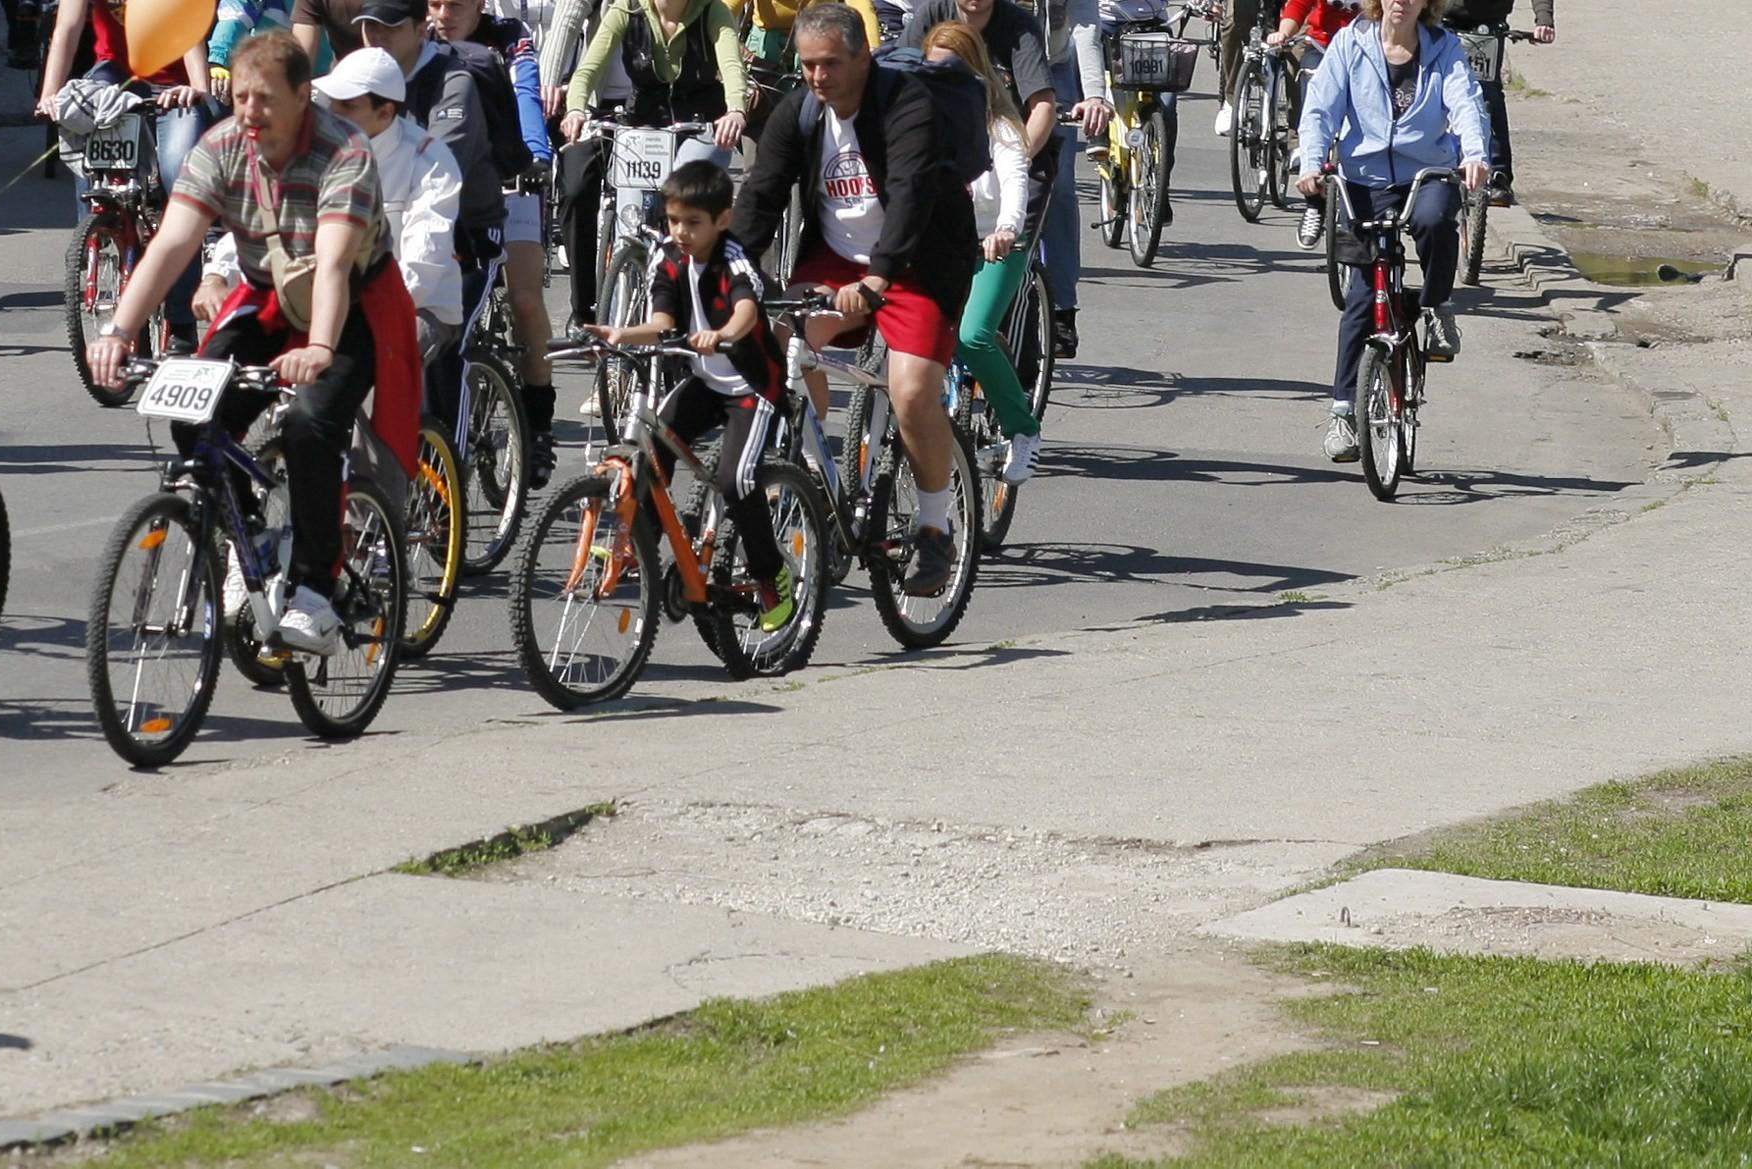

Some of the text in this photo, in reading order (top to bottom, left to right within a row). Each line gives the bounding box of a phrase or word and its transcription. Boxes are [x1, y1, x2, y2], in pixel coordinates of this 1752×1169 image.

[90, 140, 134, 161] 8630
[627, 160, 661, 180] 11139
[150, 383, 213, 410] 4909
